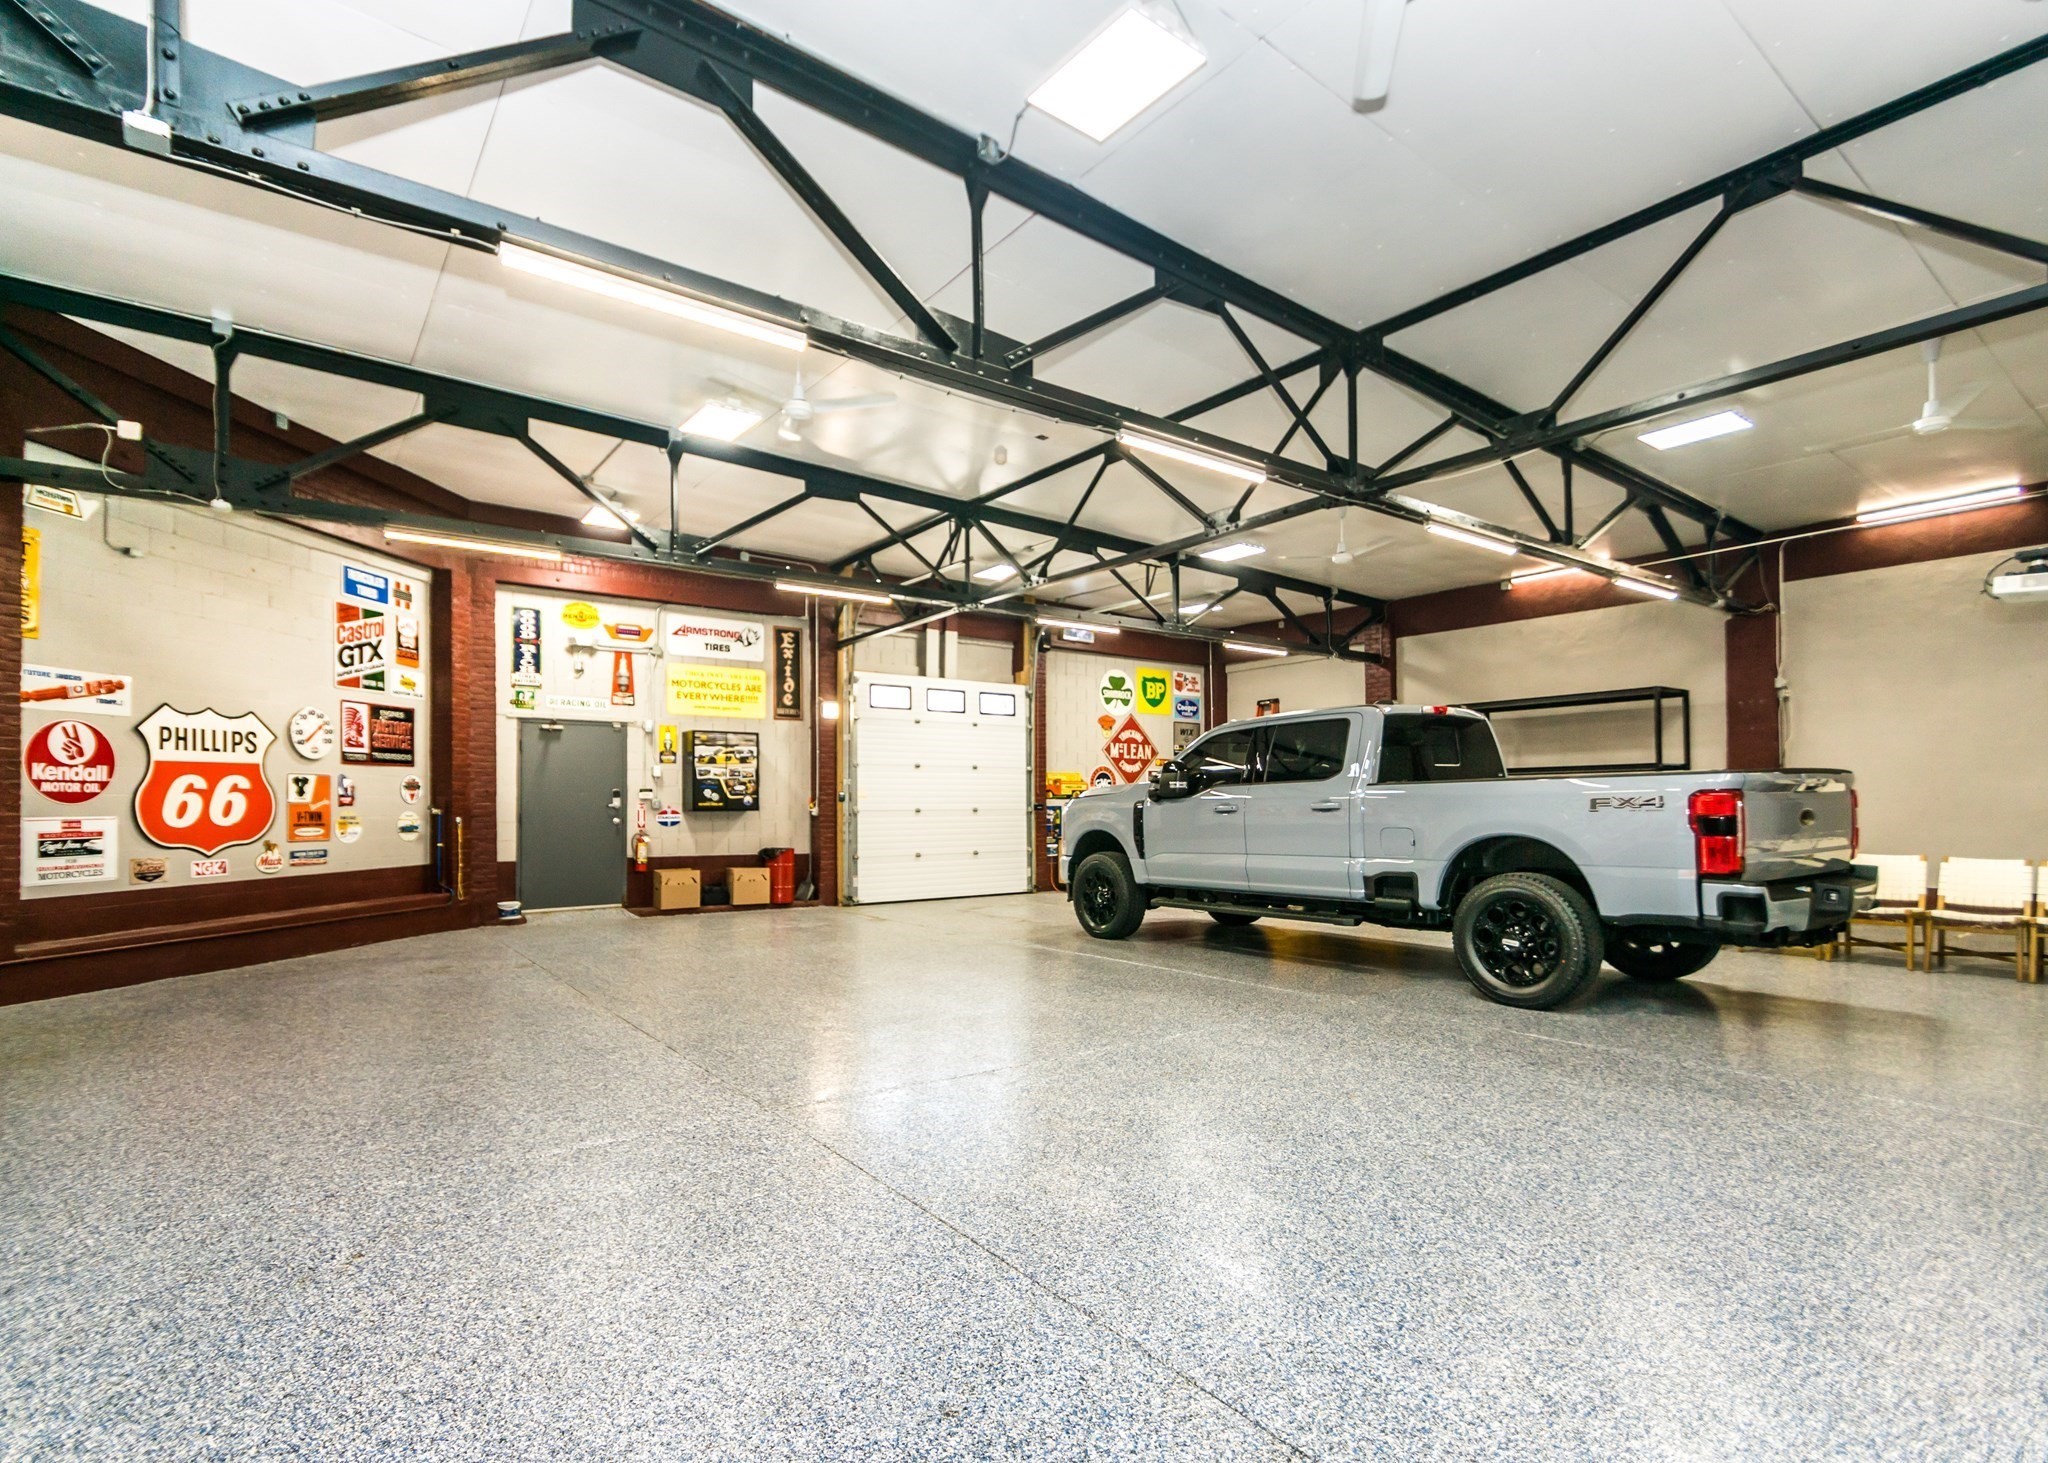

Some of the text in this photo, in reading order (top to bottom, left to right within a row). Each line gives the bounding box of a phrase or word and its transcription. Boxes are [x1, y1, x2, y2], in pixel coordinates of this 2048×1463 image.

[336, 618, 385, 645] Castrol
[672, 624, 741, 639] ARMSTRONG
[337, 639, 384, 668] GTX
[704, 642, 731, 652] TIRES
[780, 631, 796, 706] Exide
[671, 680, 763, 693] MOTORCYCLES ARE
[1145, 681, 1166, 700] BP
[560, 698, 591, 708] RACING
[594, 701, 607, 709] OIL
[1176, 703, 1198, 712] Cooper
[370, 718, 413, 736] FACTORY
[1179, 728, 1194, 737] WIX
[158, 725, 258, 754] PHILLIPS
[371, 733, 412, 750] SERVICE
[31, 762, 111, 783] Kendall
[1118, 759, 1143, 774] COMPANY
[40, 782, 101, 793] MOTOR OIL
[161, 773, 252, 829] 66
[1589, 795, 1665, 812] FX4
[297, 811, 323, 822] V-TWIN
[192, 861, 224, 876] NGK
[258, 855, 283, 867] Mack
[38, 869, 104, 881] MOTORCYCLES
